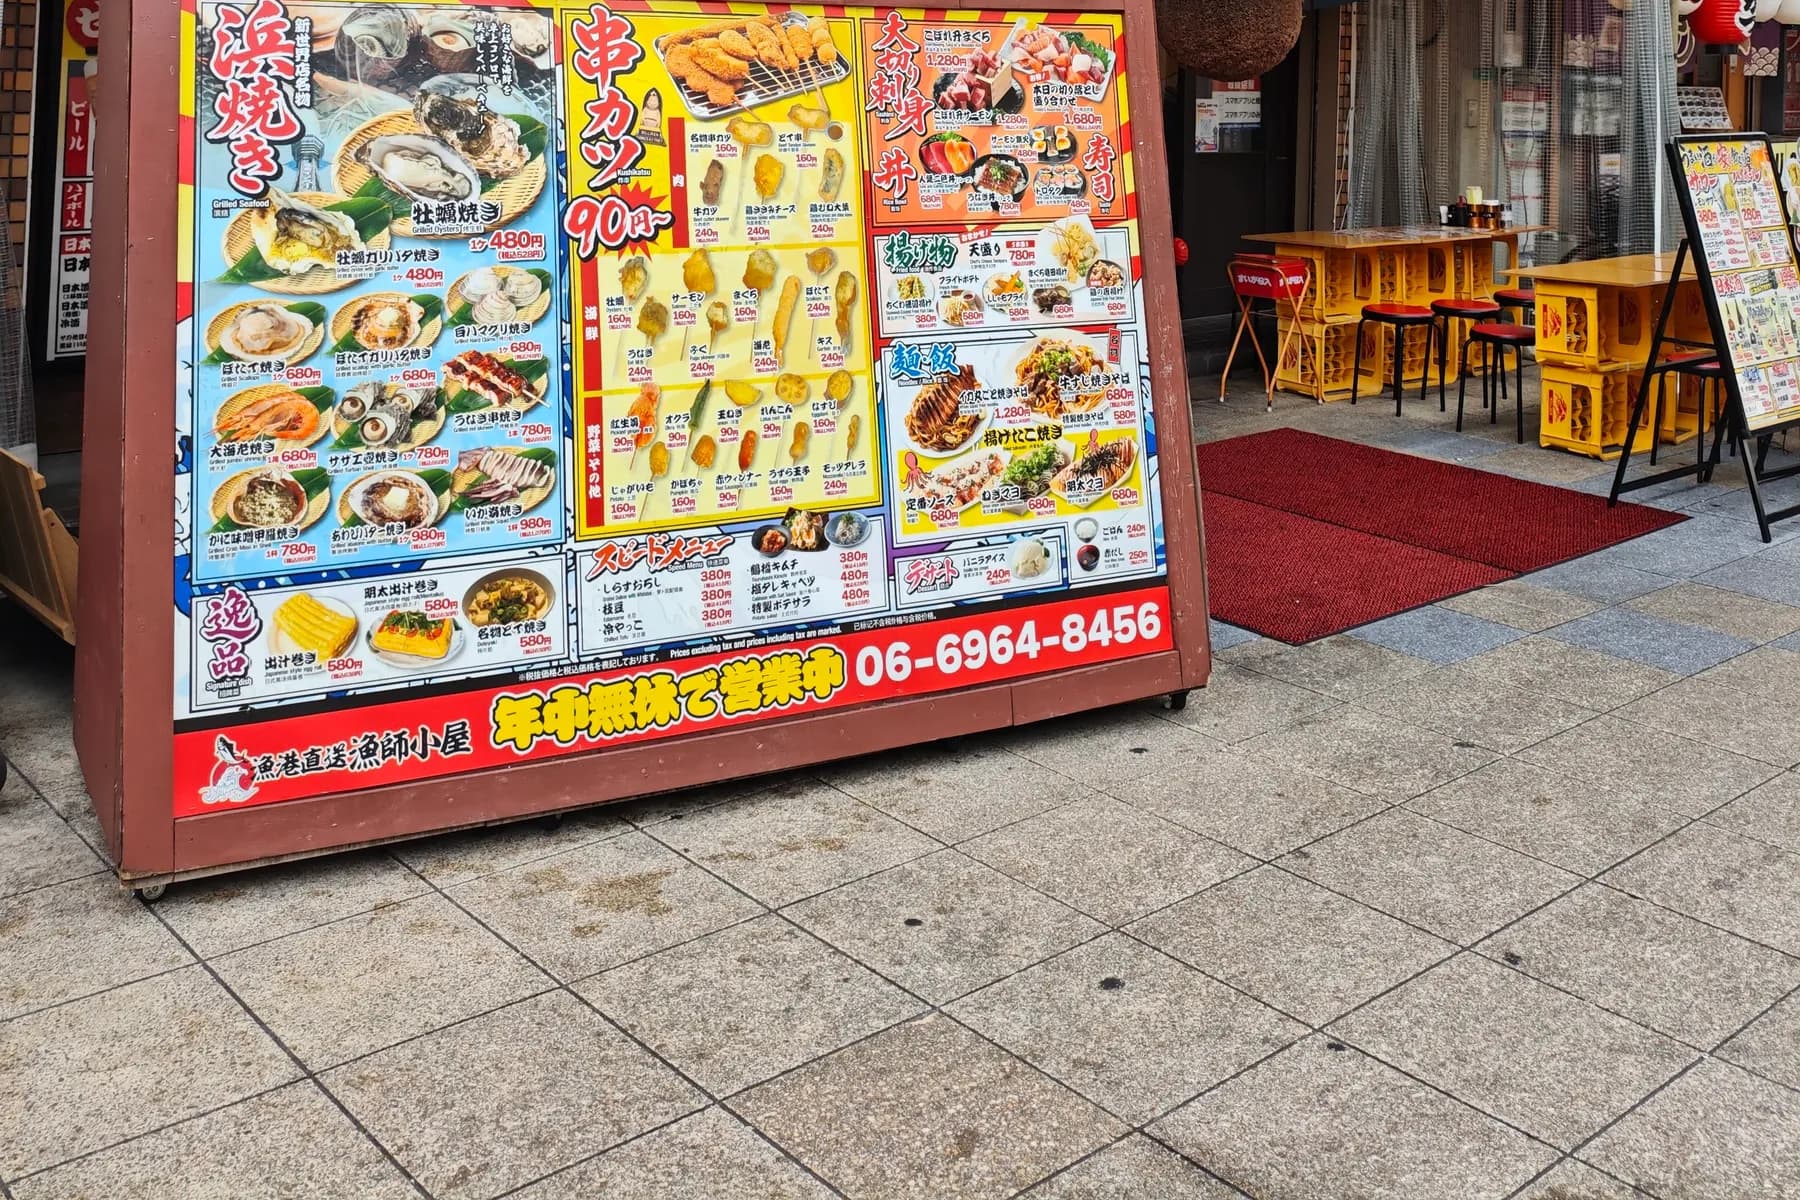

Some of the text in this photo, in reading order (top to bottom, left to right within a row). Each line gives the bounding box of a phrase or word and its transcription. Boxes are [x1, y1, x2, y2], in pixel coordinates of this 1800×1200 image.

[926, 54, 967, 67] 1,280円
[866, 11, 935, 140] 大切り刺身
[571, 4, 643, 188] 串カツ
[69, 101, 87, 152] ビール
[1063, 114, 1102, 125] 1,680円
[617, 168, 652, 177] Kushikatsu
[873, 148, 917, 198] 丼
[1084, 133, 1116, 200] 寿司
[64, 184, 83, 228] ハイボール
[213, 199, 270, 209] Grilled Seafood
[412, 202, 501, 224] 牡蠣焼き
[693, 206, 718, 217] 牛カツ
[1697, 209, 1717, 222] 380円
[1741, 208, 1761, 221] 280円
[490, 231, 543, 249] 480円
[885, 232, 956, 271] 揚げ物
[969, 242, 1001, 257] 天盛り
[939, 274, 980, 284] フライドポテト
[671, 292, 705, 302] サーモン
[733, 289, 757, 300] まぐろ
[584, 306, 599, 341] 海鮮
[816, 336, 833, 346] キス
[222, 361, 286, 376] ほたて焼き
[1059, 372, 1131, 389] 牛すじ焼きそば
[1106, 389, 1135, 401] 680円
[760, 404, 793, 416] れんこん
[994, 406, 1031, 419] 1,280円
[454, 410, 522, 425] うなぎ串焼き
[665, 413, 690, 425] オクラ
[521, 424, 552, 436] 780円
[983, 424, 1063, 446] 揚げたこ焼き
[210, 441, 275, 458] 大海老焼き
[587, 425, 602, 499] 野菜・その他
[670, 478, 702, 490] かぼちゃ
[715, 472, 762, 486] 赤ウィンナー
[1066, 478, 1105, 492] 明太マヨ
[610, 482, 655, 495] じゃがいも
[906, 496, 955, 512] 定番ソース
[1028, 499, 1056, 511] 680円
[930, 509, 959, 522] 680円
[520, 517, 552, 530] 980円
[411, 529, 445, 542] 980円
[1102, 525, 1124, 537] ごはん
[281, 543, 316, 557] 780円
[586, 536, 733, 578] スピードメニュー
[839, 551, 868, 563] 380円
[963, 552, 1007, 567] バニラアイス
[701, 569, 732, 582] 380円
[840, 569, 869, 582] 480円
[905, 558, 959, 592] デザート
[364, 579, 439, 599] 明太出汁巻き
[603, 577, 662, 595] しらすおろし
[751, 576, 816, 595] 塩タレキャベツ
[701, 589, 732, 601] 380円
[841, 588, 870, 600] 480円
[424, 598, 459, 612] 580円
[602, 603, 625, 615] 枝豆
[751, 597, 811, 614] 特製ポテサラ
[702, 609, 732, 621] 380円
[203, 588, 260, 679] 逸品
[478, 620, 547, 640] 名物どて焼き
[602, 620, 643, 636] 冷やっこ
[520, 634, 552, 648] 580円
[670, 648, 690, 658] Prices
[691, 643, 721, 655] excluding
[734, 639, 746, 649] and
[747, 637, 766, 648] prices
[767, 632, 796, 645] including
[855, 602, 1162, 688] 06-6964-8456
[265, 653, 317, 670] 出汁巻き
[328, 658, 363, 672] 580円
[489, 647, 847, 751] 年中無休で営業中
[249, 720, 473, 782] 漁港直送漁師小屋
